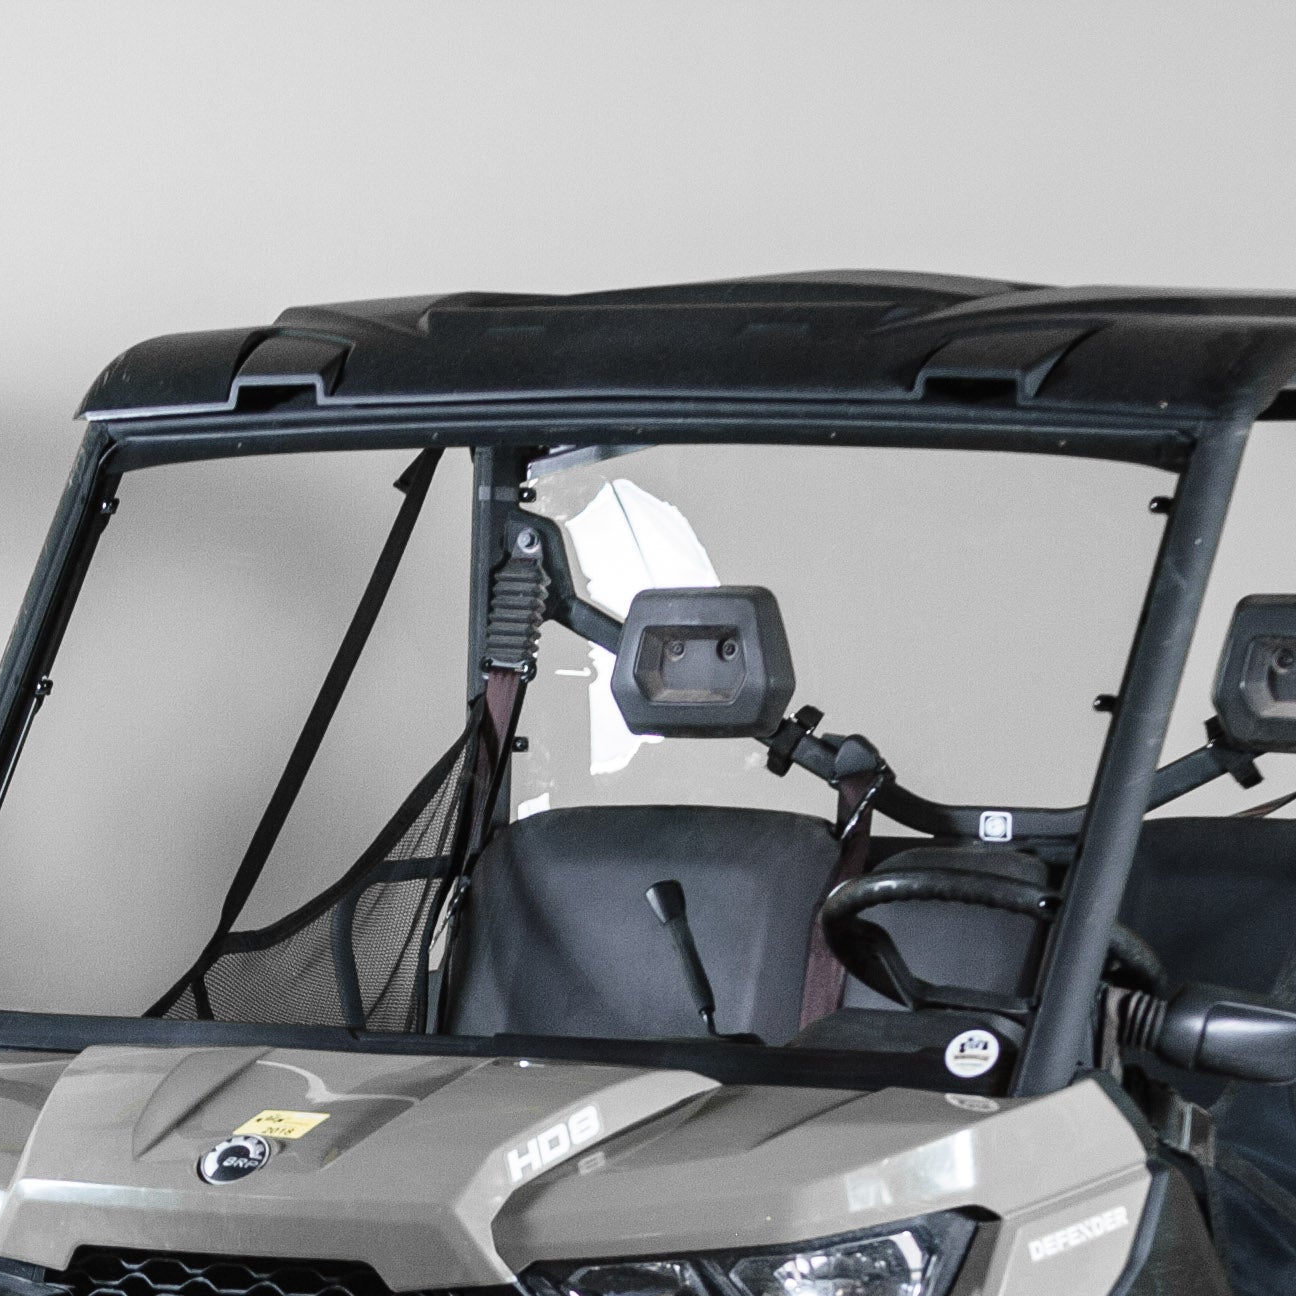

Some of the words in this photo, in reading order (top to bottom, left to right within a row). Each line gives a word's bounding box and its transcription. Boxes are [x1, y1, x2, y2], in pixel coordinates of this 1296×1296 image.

[223, 1156, 259, 1168] BRP
[507, 1105, 600, 1182] HD8
[1028, 1205, 1129, 1261] DEFENDER
